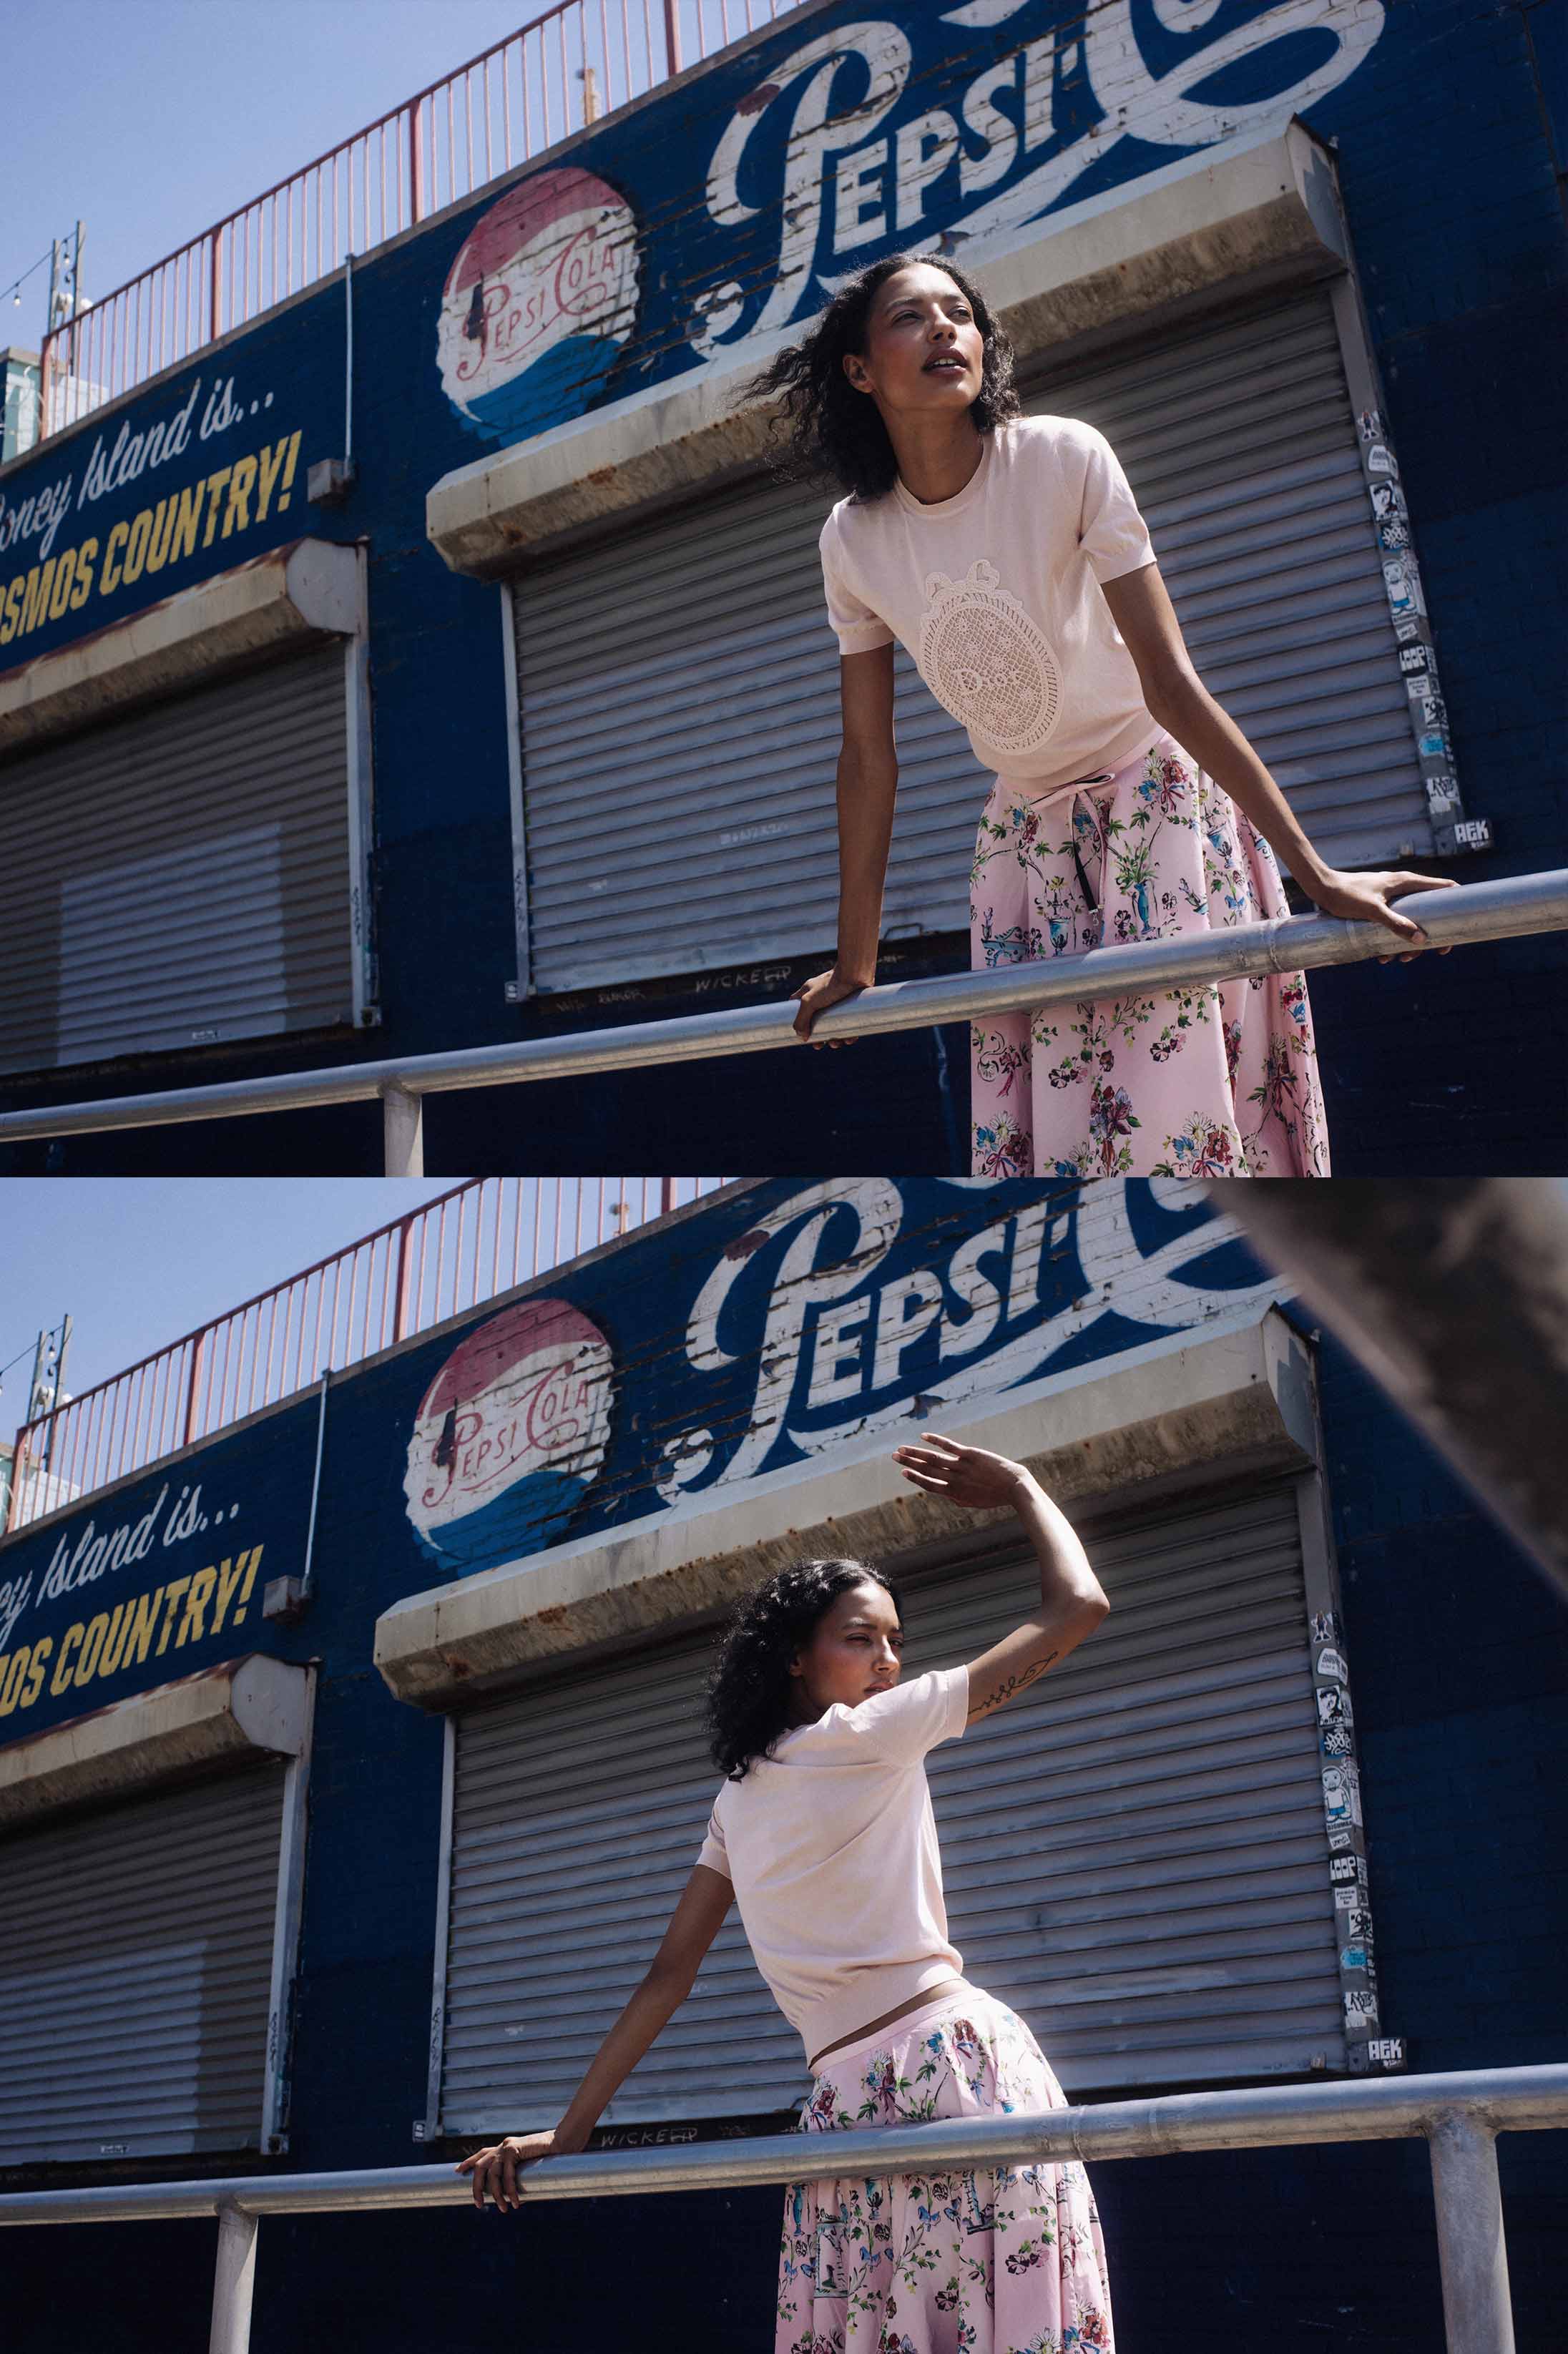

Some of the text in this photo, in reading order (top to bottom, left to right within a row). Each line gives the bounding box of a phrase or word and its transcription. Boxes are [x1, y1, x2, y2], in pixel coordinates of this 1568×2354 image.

[78, 377, 201, 511] Island
[0, 430, 303, 644] SMOS COUNTRY!
[36, 1483, 168, 1608] Island
[49, 1544, 265, 1696] COUNTRY!
[1329, 1855, 1356, 1881] LOOP
